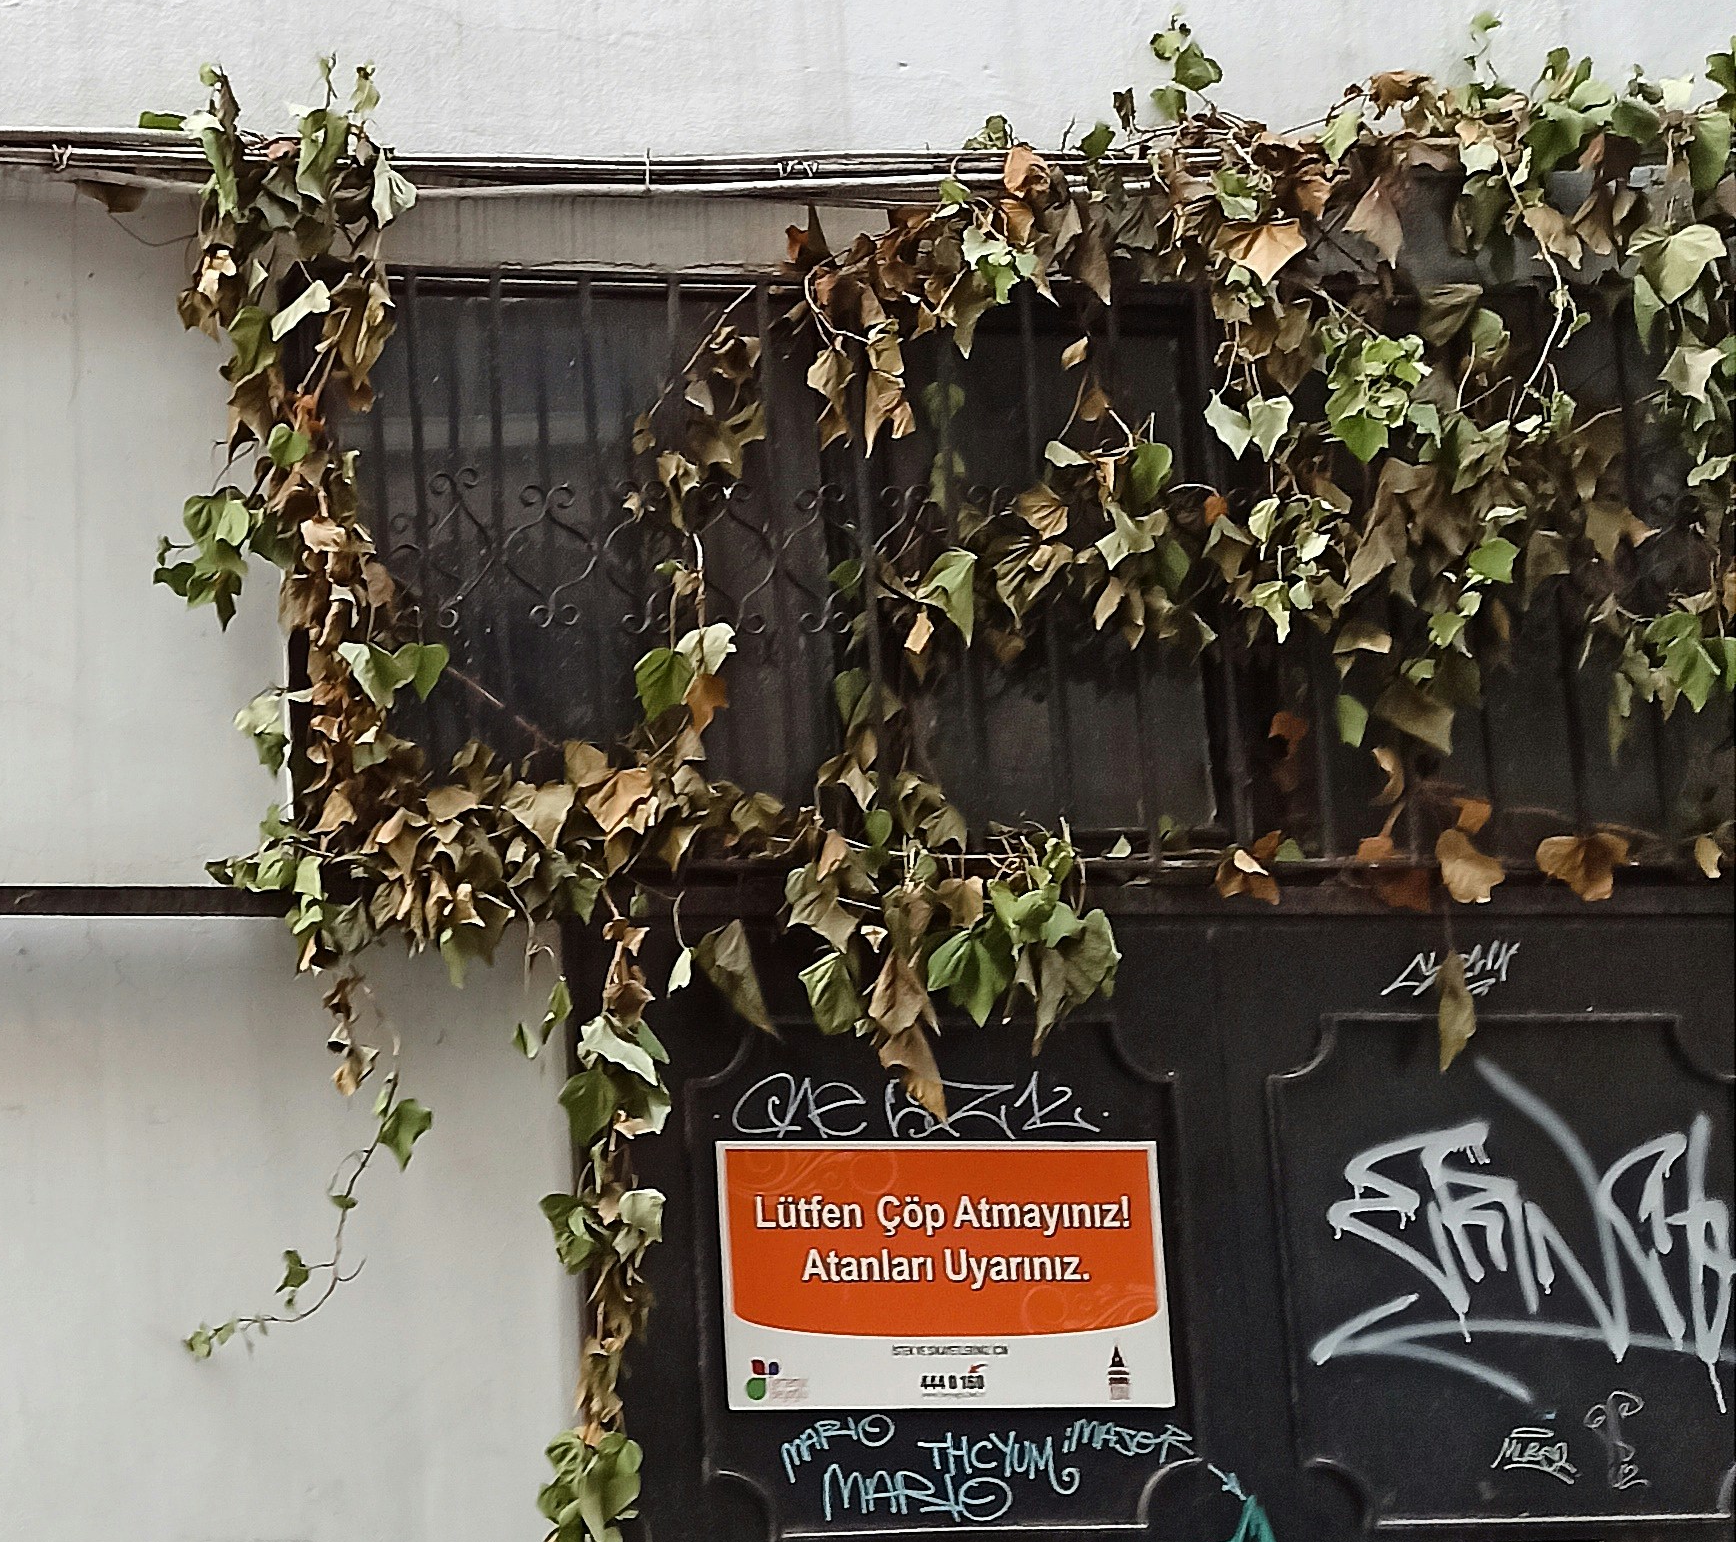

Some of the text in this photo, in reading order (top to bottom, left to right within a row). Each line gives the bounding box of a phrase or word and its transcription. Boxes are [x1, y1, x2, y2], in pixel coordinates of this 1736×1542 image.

[754, 1195, 1131, 1237] Lütfen Çöp Atmayınız!
[801, 1248, 1091, 1290] Atanları Uyarınız.
[920, 1374, 946, 1390] 444
